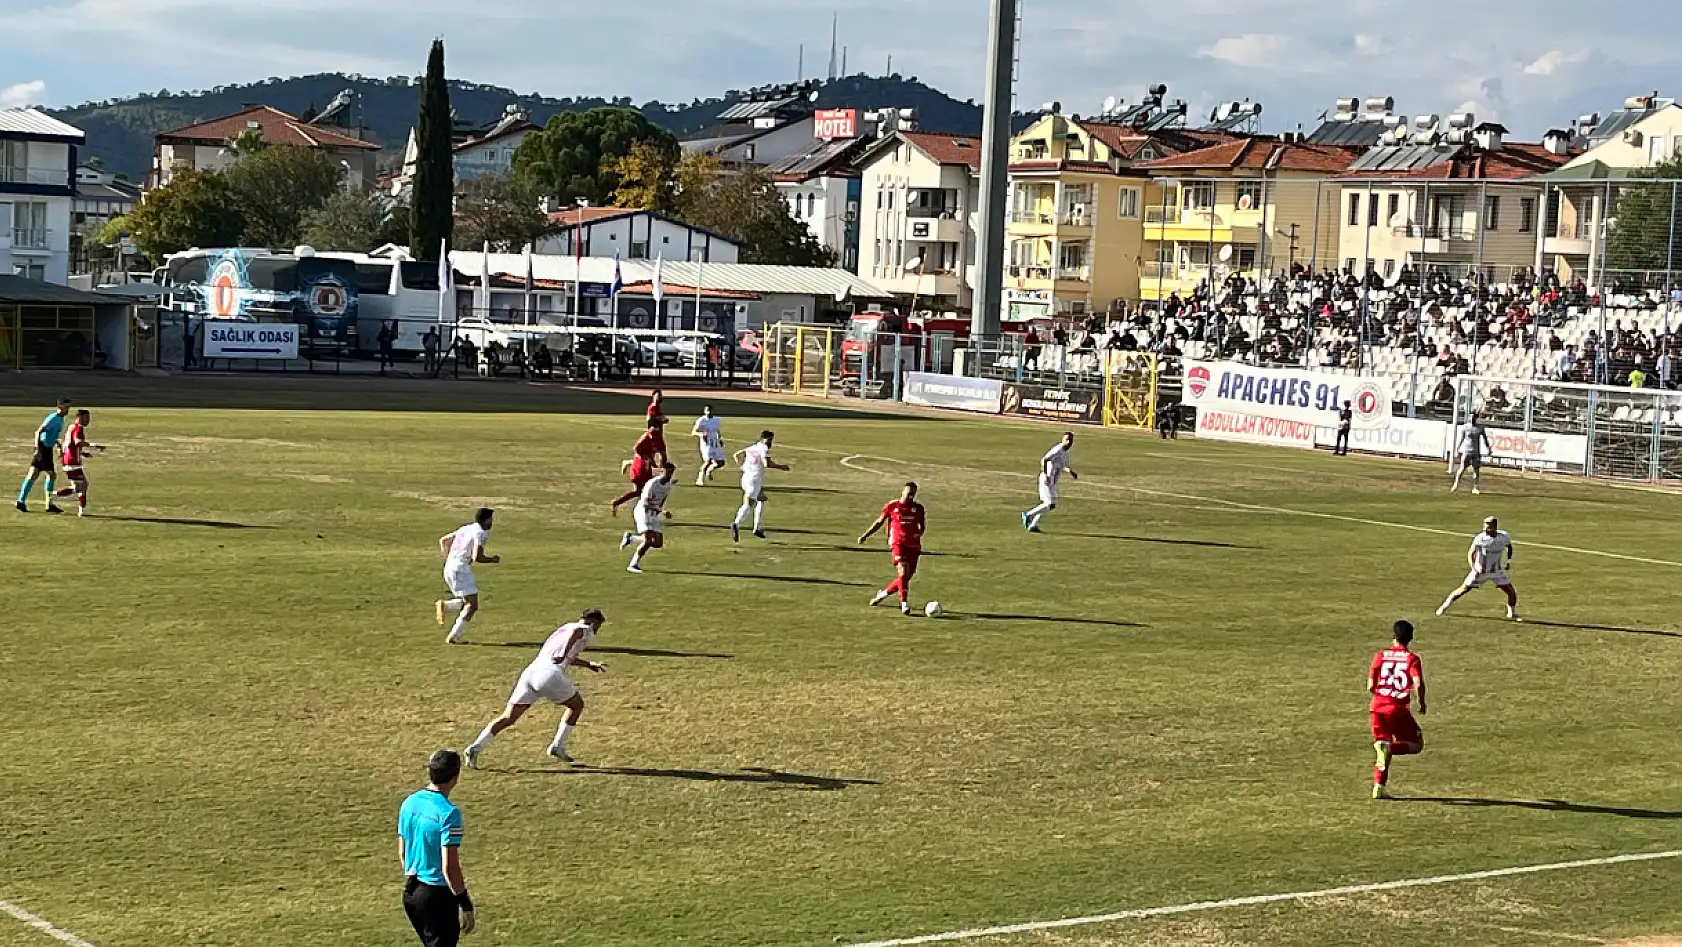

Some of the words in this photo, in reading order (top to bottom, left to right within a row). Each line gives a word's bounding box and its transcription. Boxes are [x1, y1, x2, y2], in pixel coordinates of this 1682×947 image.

[814, 119, 854, 136] HOTEL
[211, 327, 255, 342] SAĞLIK
[258, 330, 294, 343] ODASI
[1217, 371, 1311, 408] APACHES
[1315, 383, 1341, 411] 91
[1200, 411, 1256, 434] ABDULLAH
[1255, 415, 1312, 440] KOYUNCU
[1378, 661, 1408, 690] 55
